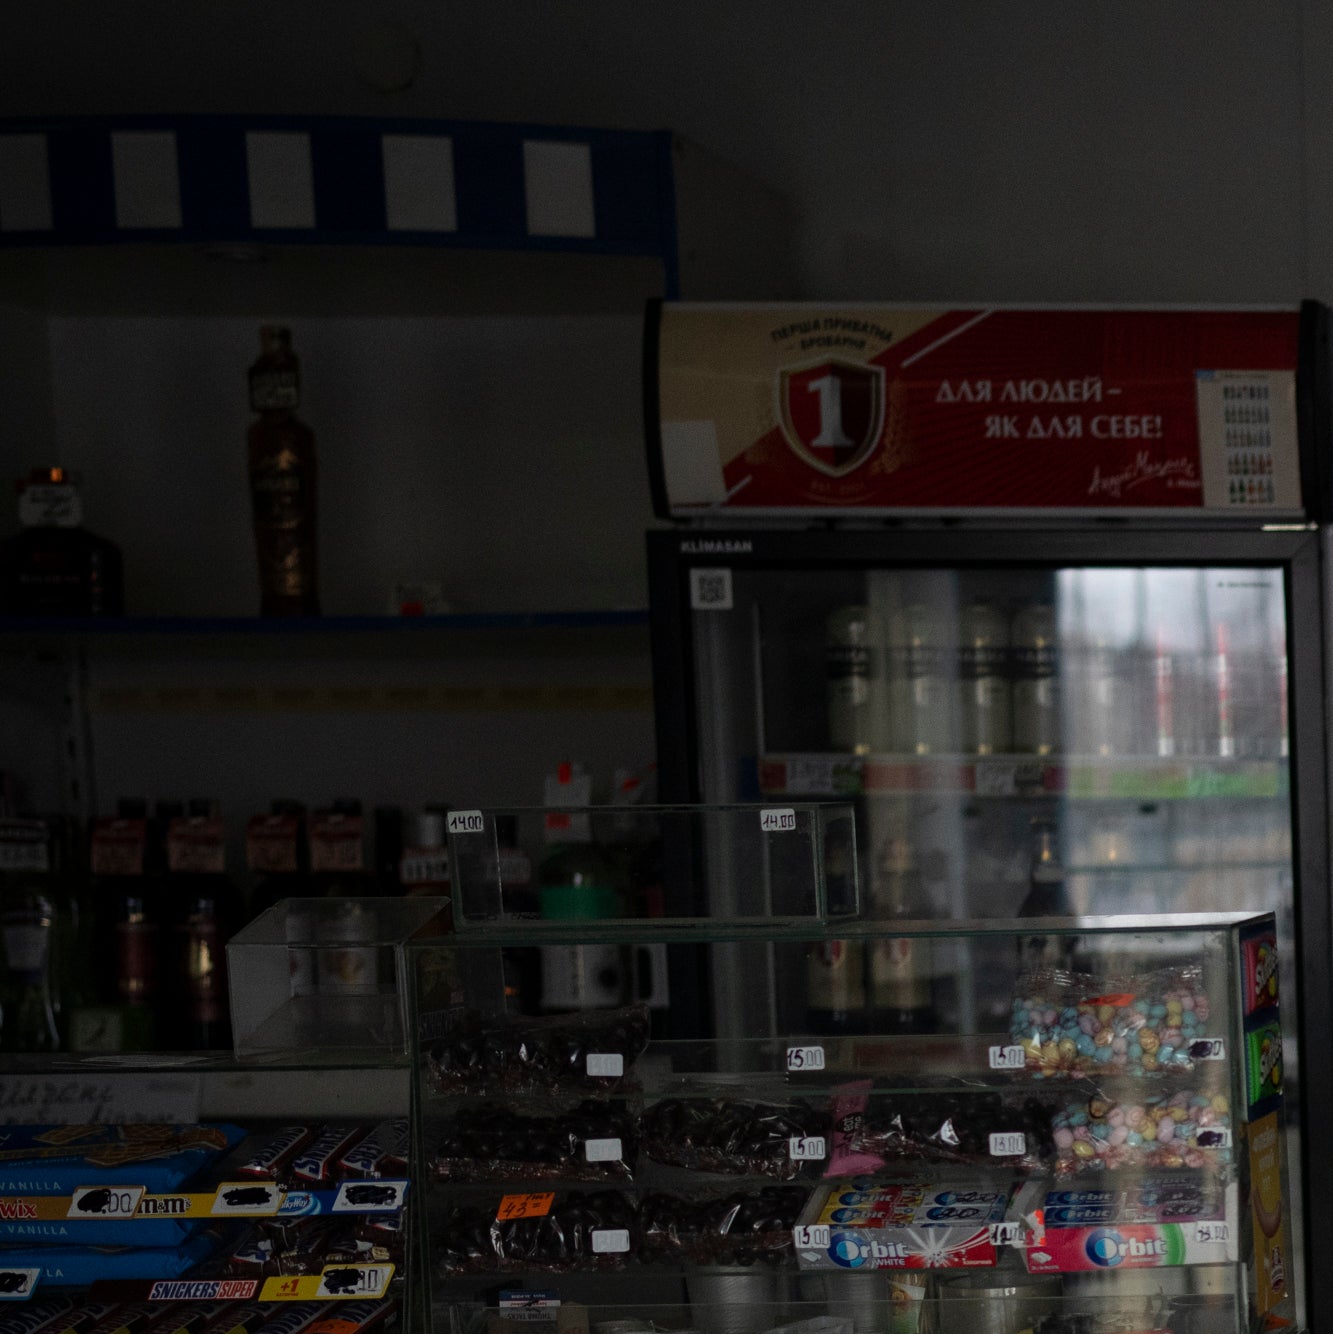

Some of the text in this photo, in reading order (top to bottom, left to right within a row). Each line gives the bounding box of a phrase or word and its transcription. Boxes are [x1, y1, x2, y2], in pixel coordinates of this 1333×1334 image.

[771, 317, 893, 342] ПЕРША ПРИВАТНА
[801, 335, 867, 349] БРОВАРНЯ
[934, 378, 993, 404] ДЛЯ
[999, 374, 1104, 404] ЛЮДЕЙ
[806, 374, 857, 448] 1
[983, 413, 1164, 440] ЯК ДЛЯ СЕБЕ!
[831, 1208, 886, 1223] Orbit
[7, 1225, 68, 1236] VANILLA
[828, 1232, 909, 1268] Orbit
[1085, 1228, 1167, 1267] Orbit
[877, 1258, 906, 1267] WHITE
[151, 1281, 218, 1299] SNICKERS
[218, 1280, 257, 1298] SUPER
